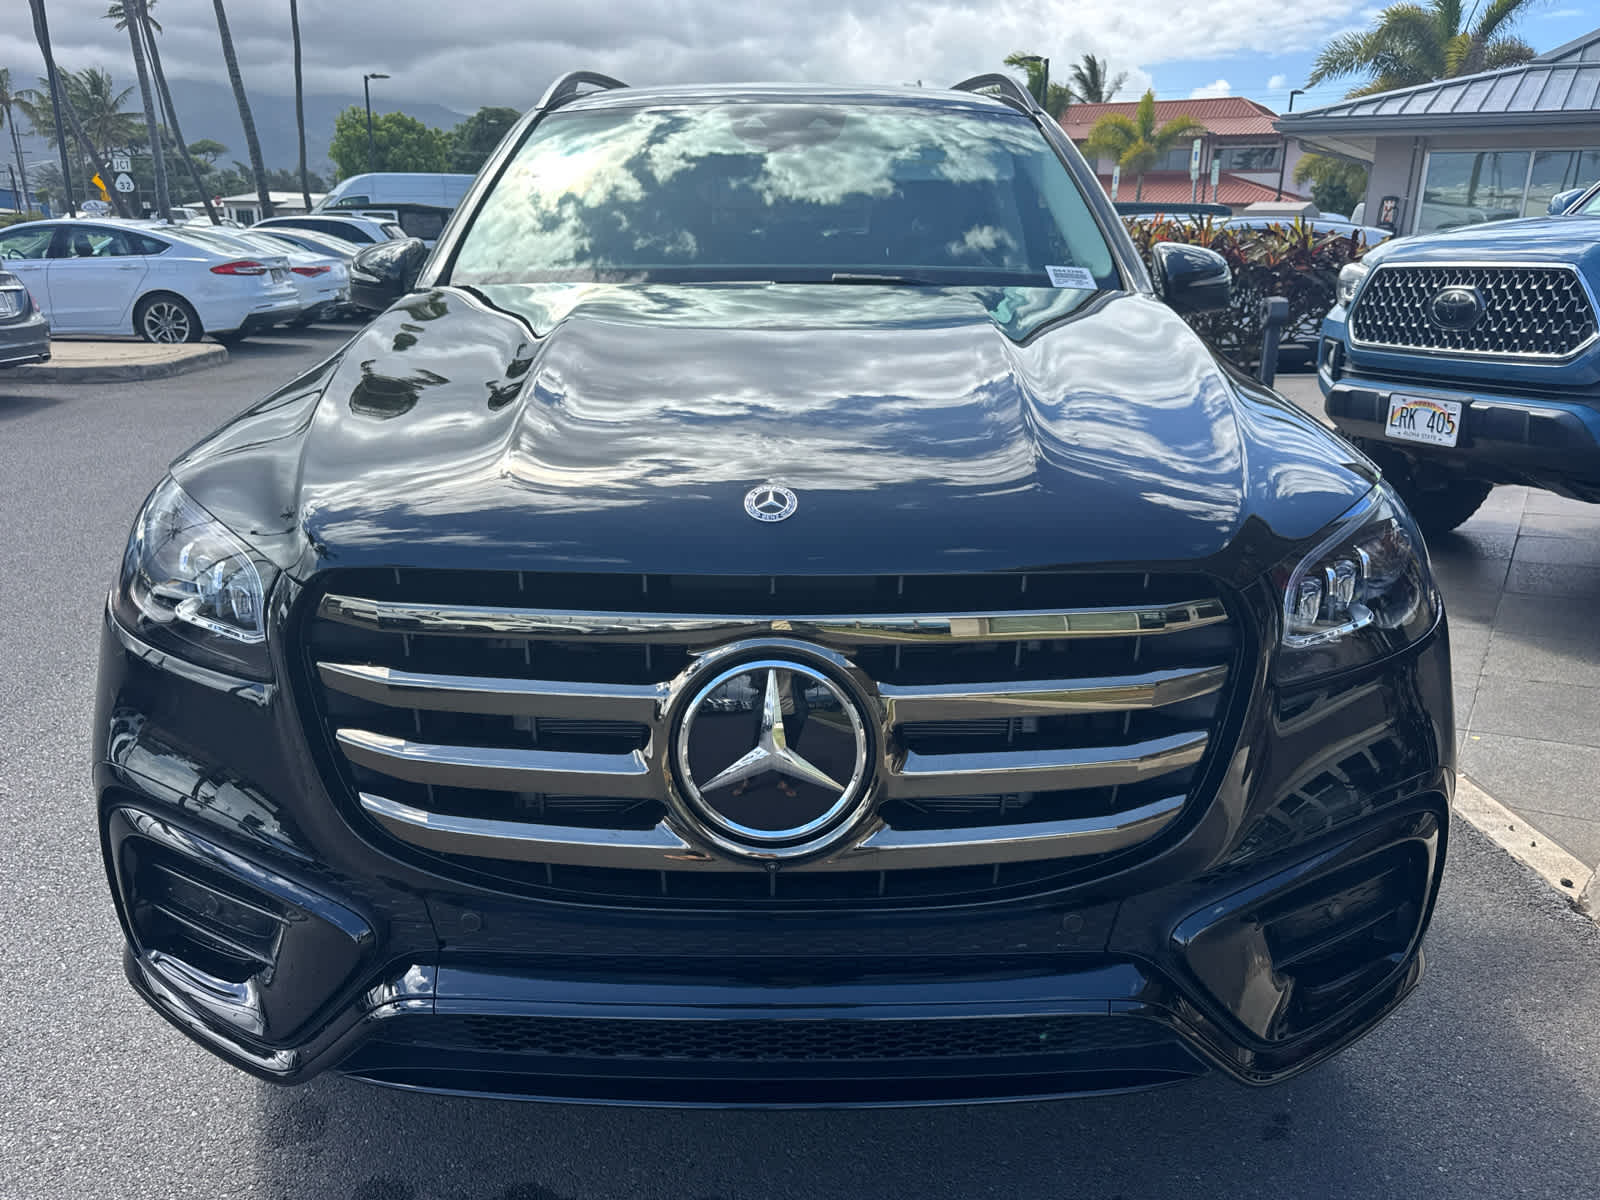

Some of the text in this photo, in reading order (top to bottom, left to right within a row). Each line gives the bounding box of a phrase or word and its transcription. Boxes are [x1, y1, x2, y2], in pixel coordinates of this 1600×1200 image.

[114, 160, 129, 169] JCT
[119, 181, 131, 190] 32
[1390, 404, 1457, 435] LRK 405
